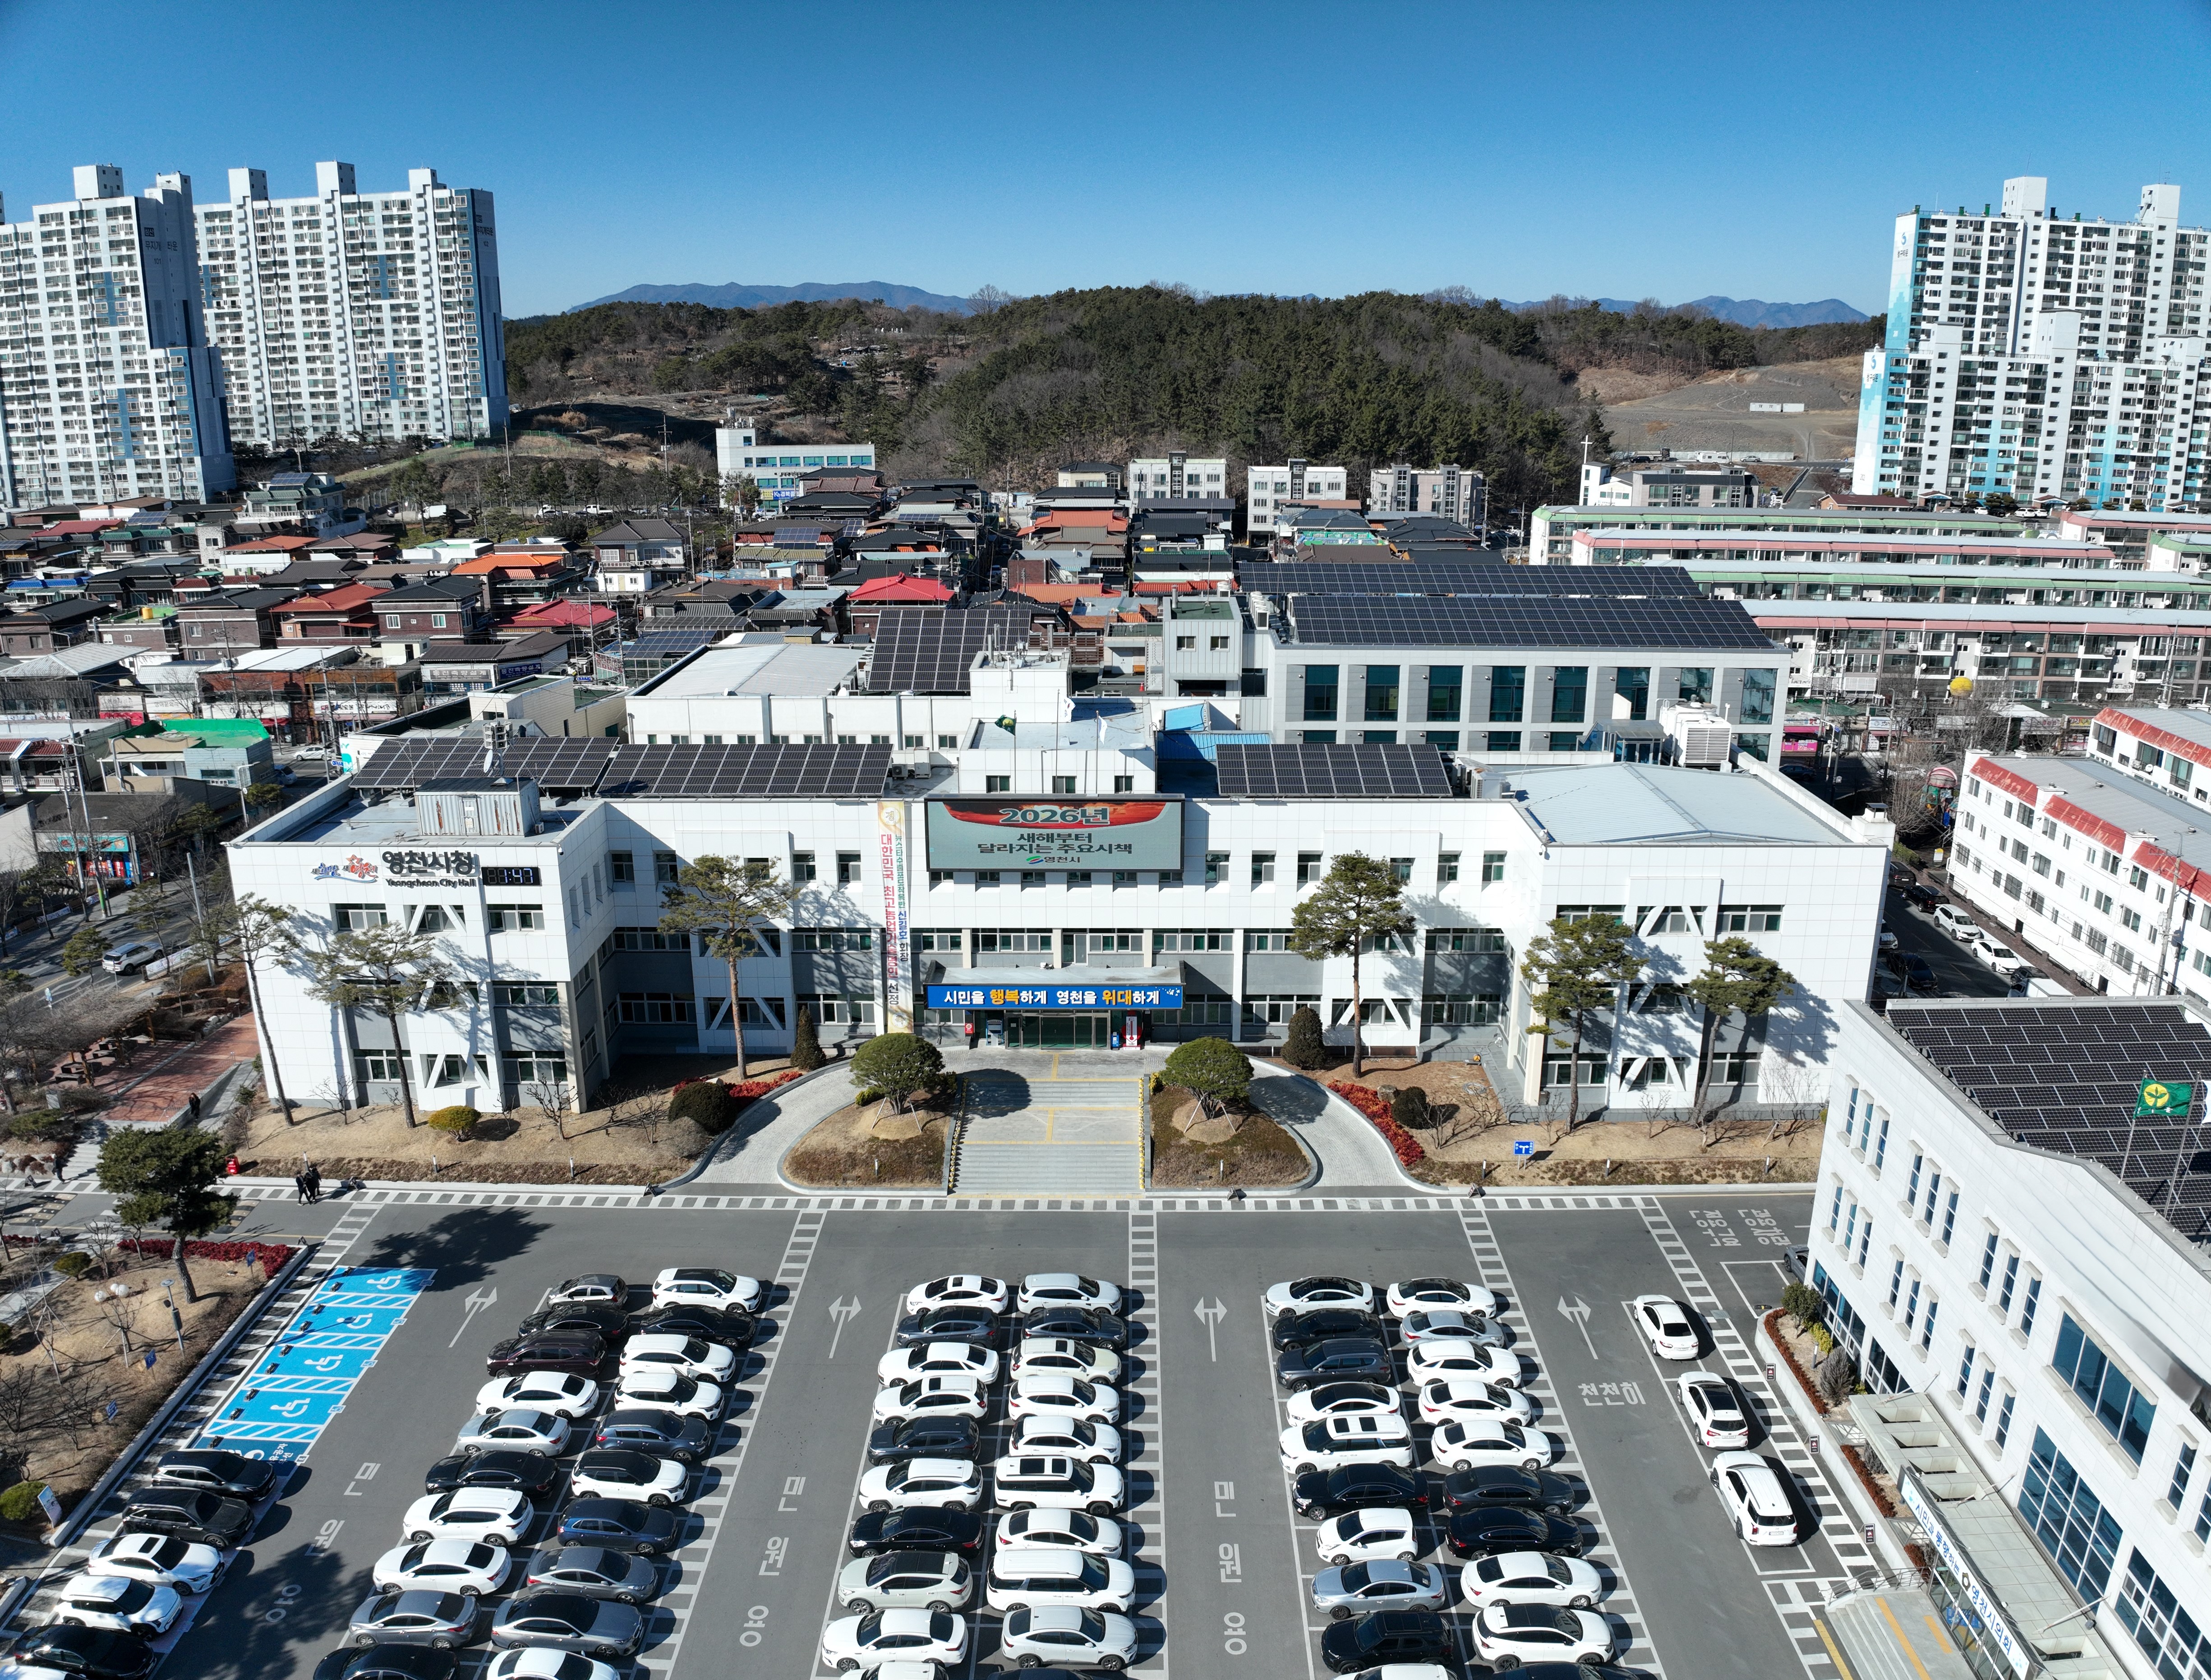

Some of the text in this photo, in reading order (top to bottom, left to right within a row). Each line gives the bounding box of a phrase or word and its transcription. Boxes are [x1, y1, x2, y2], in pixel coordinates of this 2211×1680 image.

[885, 810, 894, 821] 경
[999, 807, 1110, 825] 2026년
[1017, 833, 1092, 843] 새해부터
[977, 843, 1132, 854] 달라지는 주요시책
[382, 850, 473, 875] 영천시청
[385, 878, 475, 888] Yeongcheon City Hall
[503, 868, 534, 884] 1:47
[881, 833, 894, 881] 대한민국
[888, 983, 899, 1005] 선정
[899, 942, 908, 962] 회장
[944, 989, 1160, 1005] 시민을 행복하게 영천을 위대하게
[1577, 1381, 1646, 1406] 천천히
[1915, 1503, 2012, 1656] 시민과 동행하는 영천시의회
